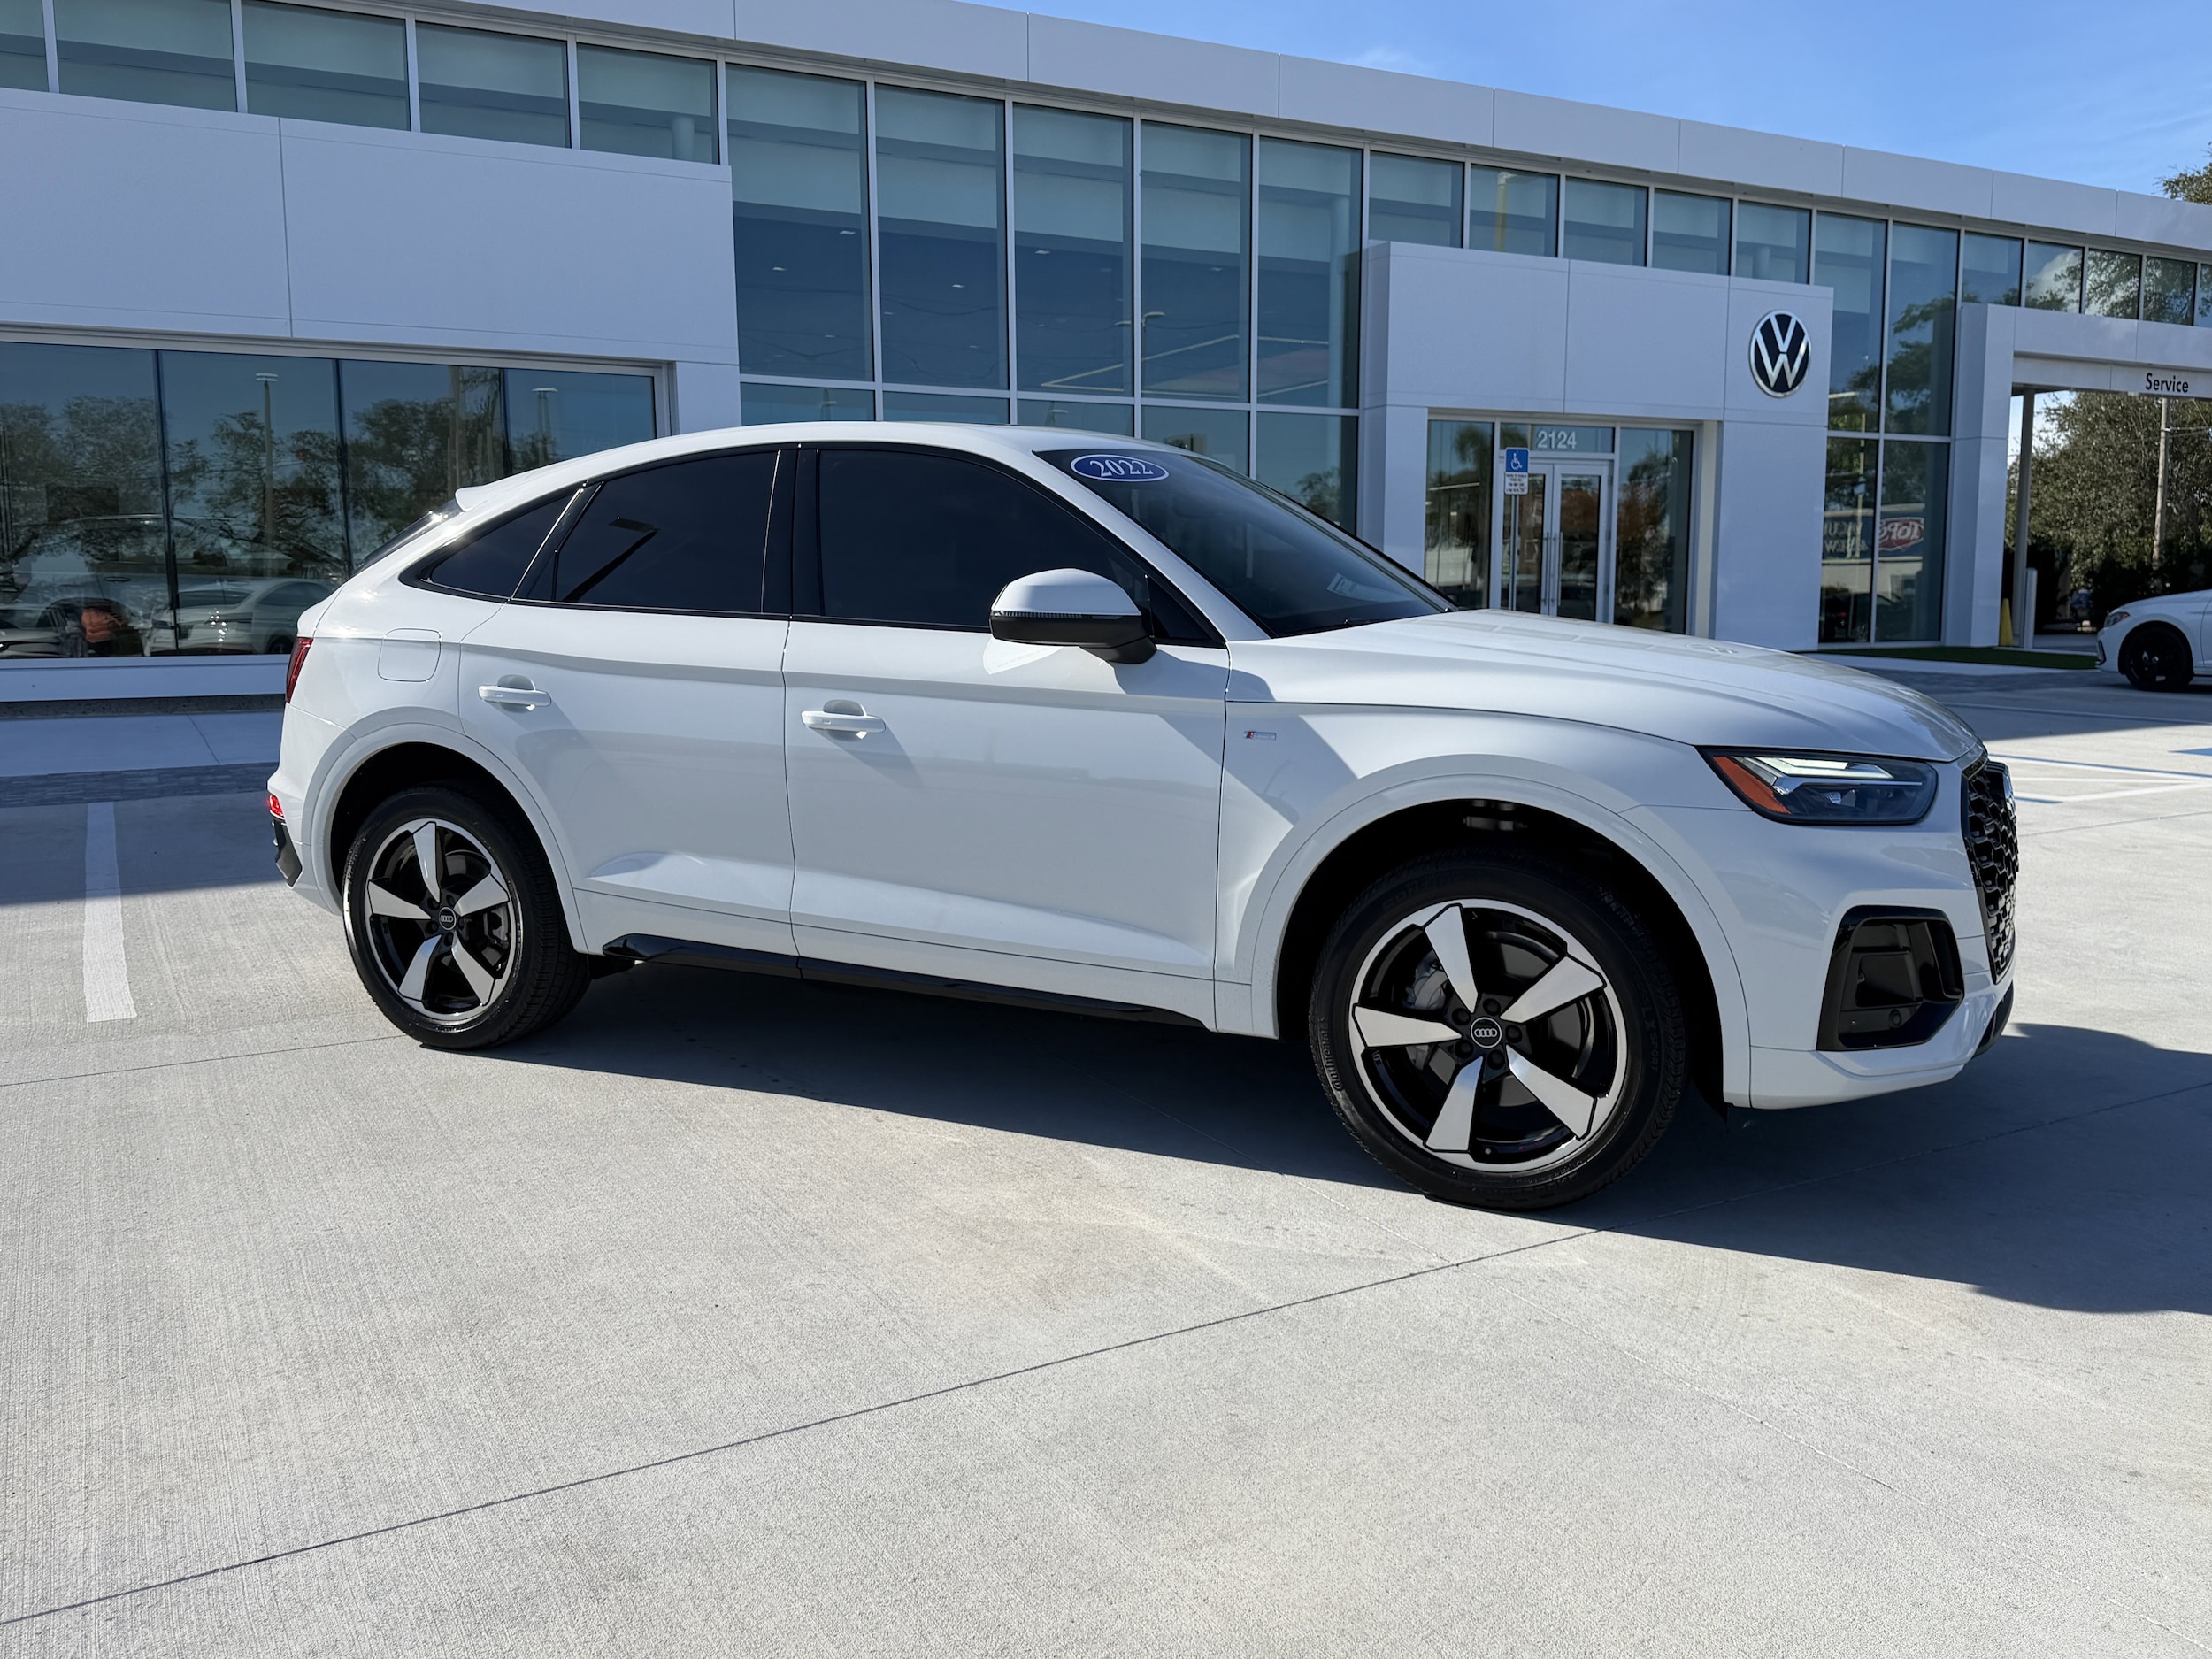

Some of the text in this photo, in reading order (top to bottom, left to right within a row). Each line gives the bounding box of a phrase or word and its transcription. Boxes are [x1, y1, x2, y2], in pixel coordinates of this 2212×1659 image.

[1753, 312, 1808, 390] VW
[2146, 372, 2189, 393] Service
[1537, 430, 1577, 449] 2124
[1089, 459, 1154, 477] 2022
[1318, 1027, 1343, 1092] Continental
